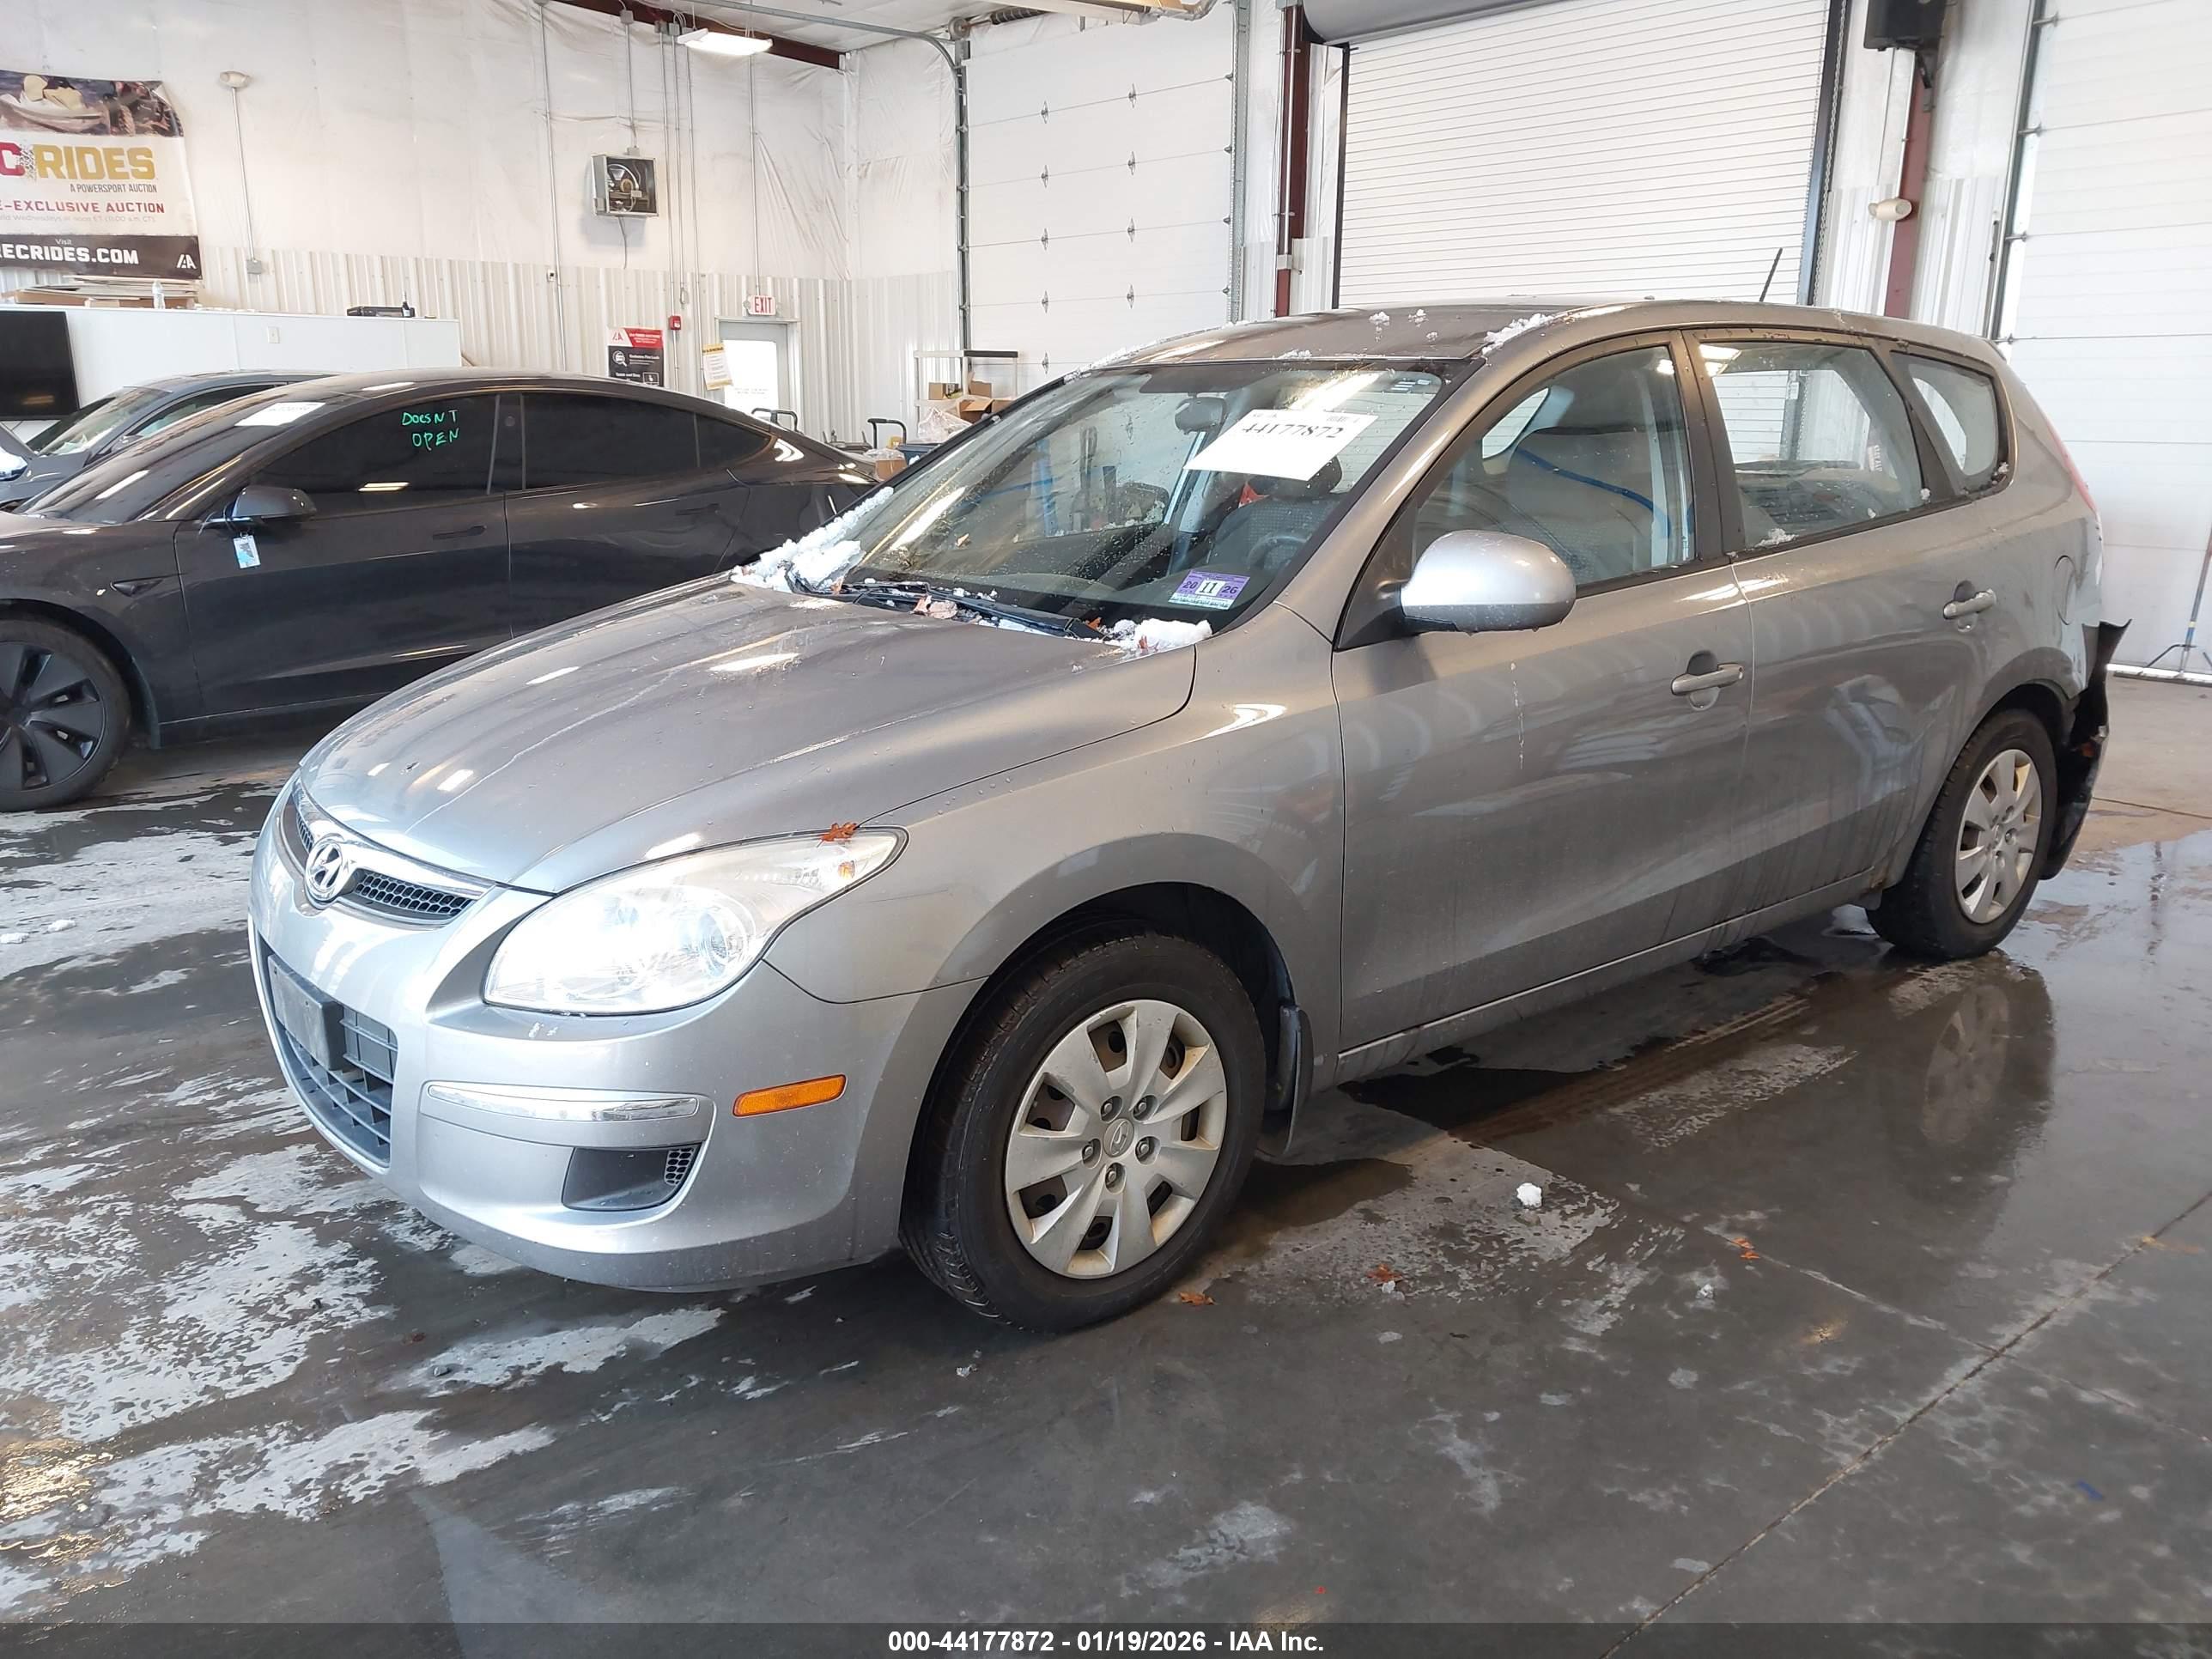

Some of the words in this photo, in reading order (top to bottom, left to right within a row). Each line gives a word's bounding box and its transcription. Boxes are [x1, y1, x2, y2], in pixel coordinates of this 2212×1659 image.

[33, 143, 156, 180] RIDES
[70, 184, 76, 192] A
[77, 184, 127, 193] POWERSPORT
[129, 184, 158, 193] AUCTION
[106, 202, 165, 214] AUCTION
[0, 243, 139, 264] ECRIDES.COM
[754, 296, 773, 313] EXIT
[1243, 423, 1344, 438] 44177872
[412, 428, 459, 451] OPEN
[1182, 580, 1199, 589] 20
[1199, 581, 1218, 593] 11
[1221, 586, 1238, 594] 26
